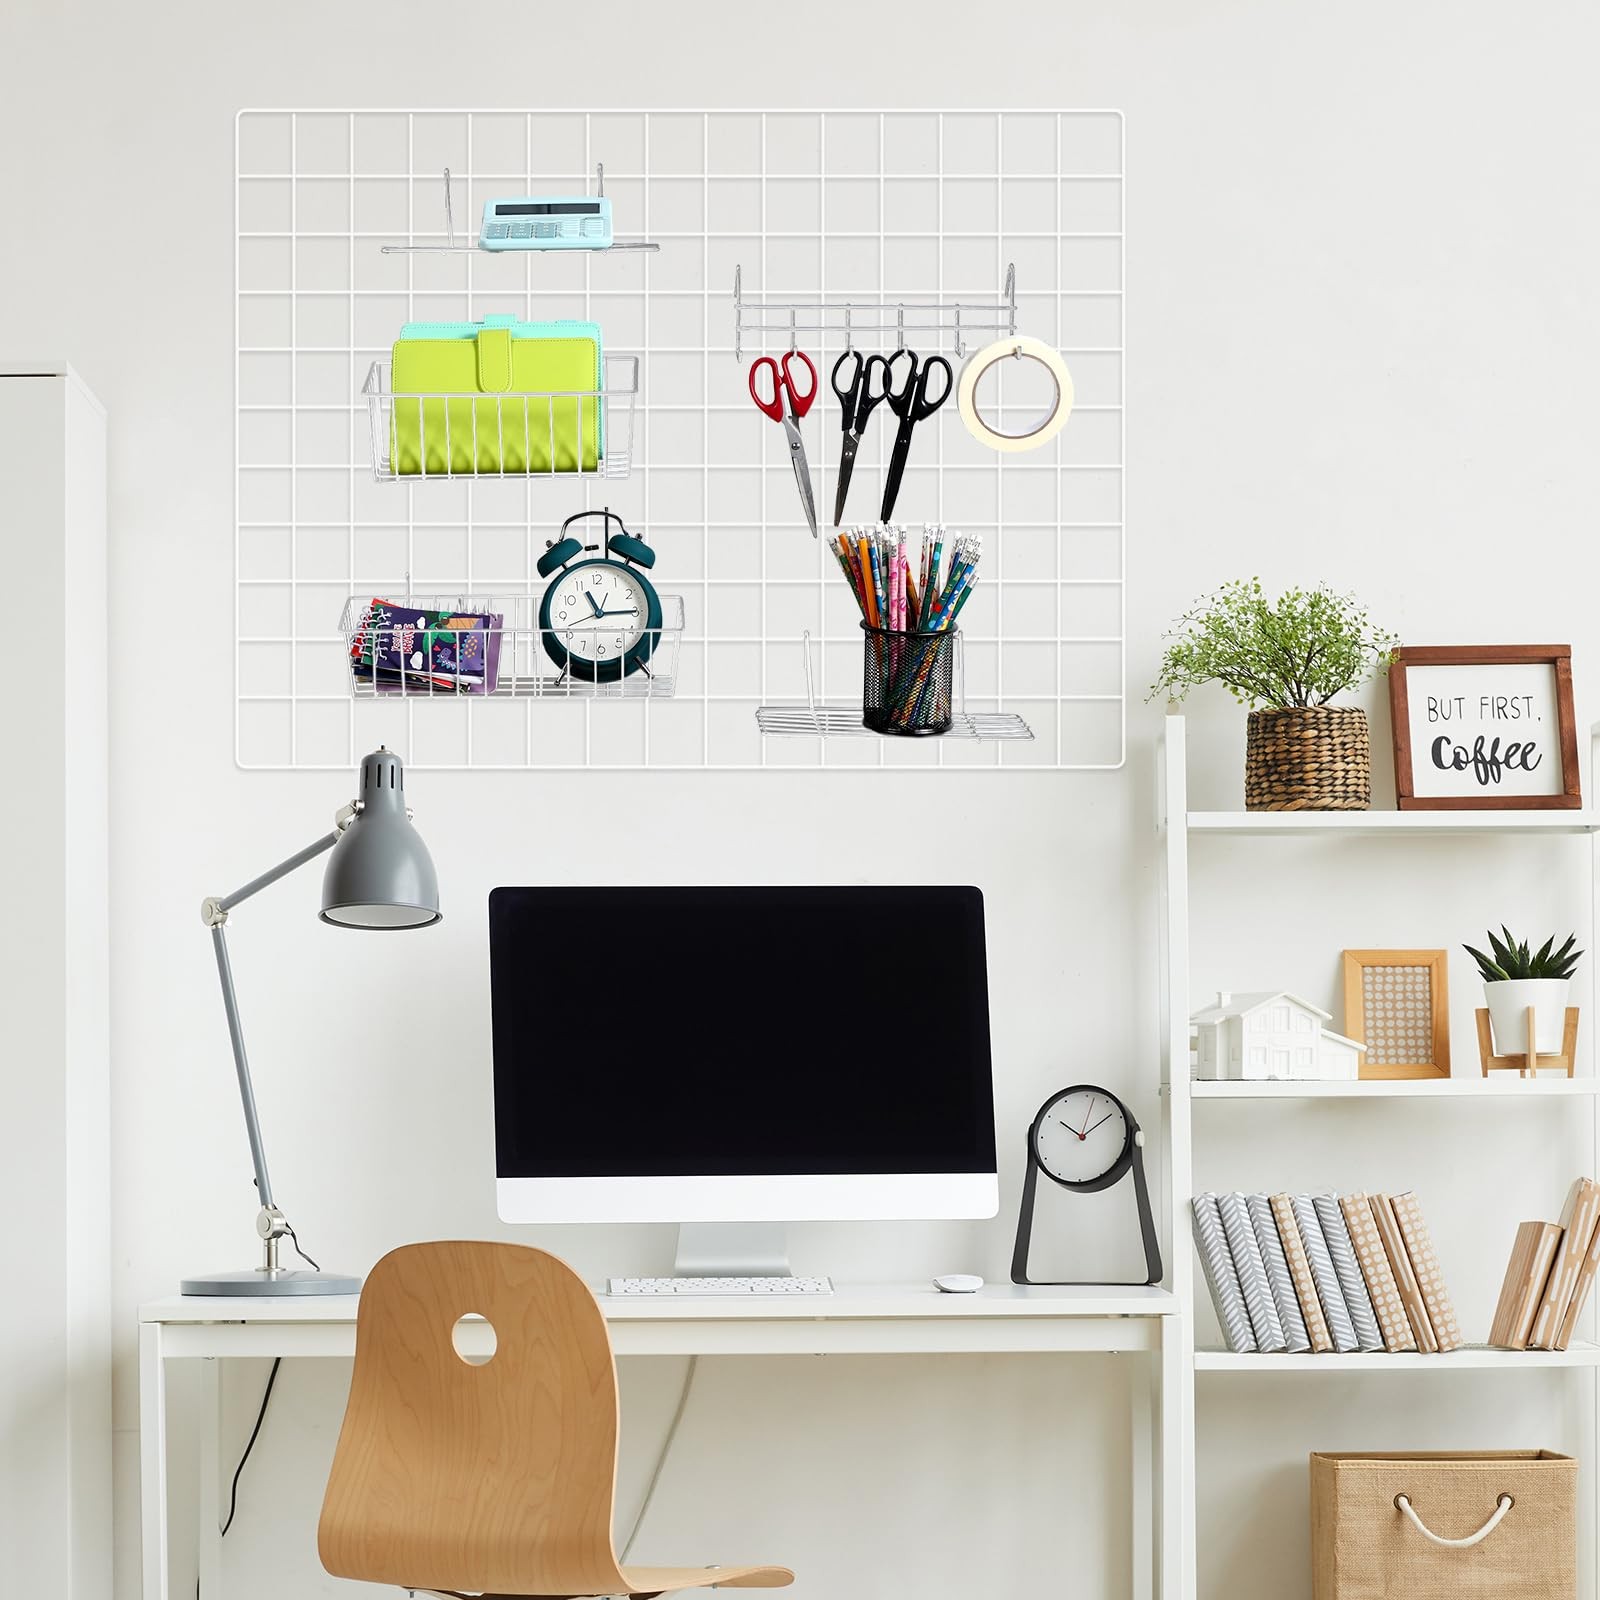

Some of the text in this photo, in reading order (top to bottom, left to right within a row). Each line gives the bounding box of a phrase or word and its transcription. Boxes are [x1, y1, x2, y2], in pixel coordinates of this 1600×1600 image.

[592, 574, 603, 585] 12
[576, 581, 584, 591] 11
[564, 594, 577, 606] 10
[625, 588, 633, 600] 2
[559, 610, 568, 621] 9
[631, 606, 640, 618] 3
[580, 640, 587, 652] 7
[597, 643, 606, 655] 6
[615, 637, 623, 649] 5
[1427, 696, 1466, 723] BUT
[1431, 735, 1543, 786] Coffee
